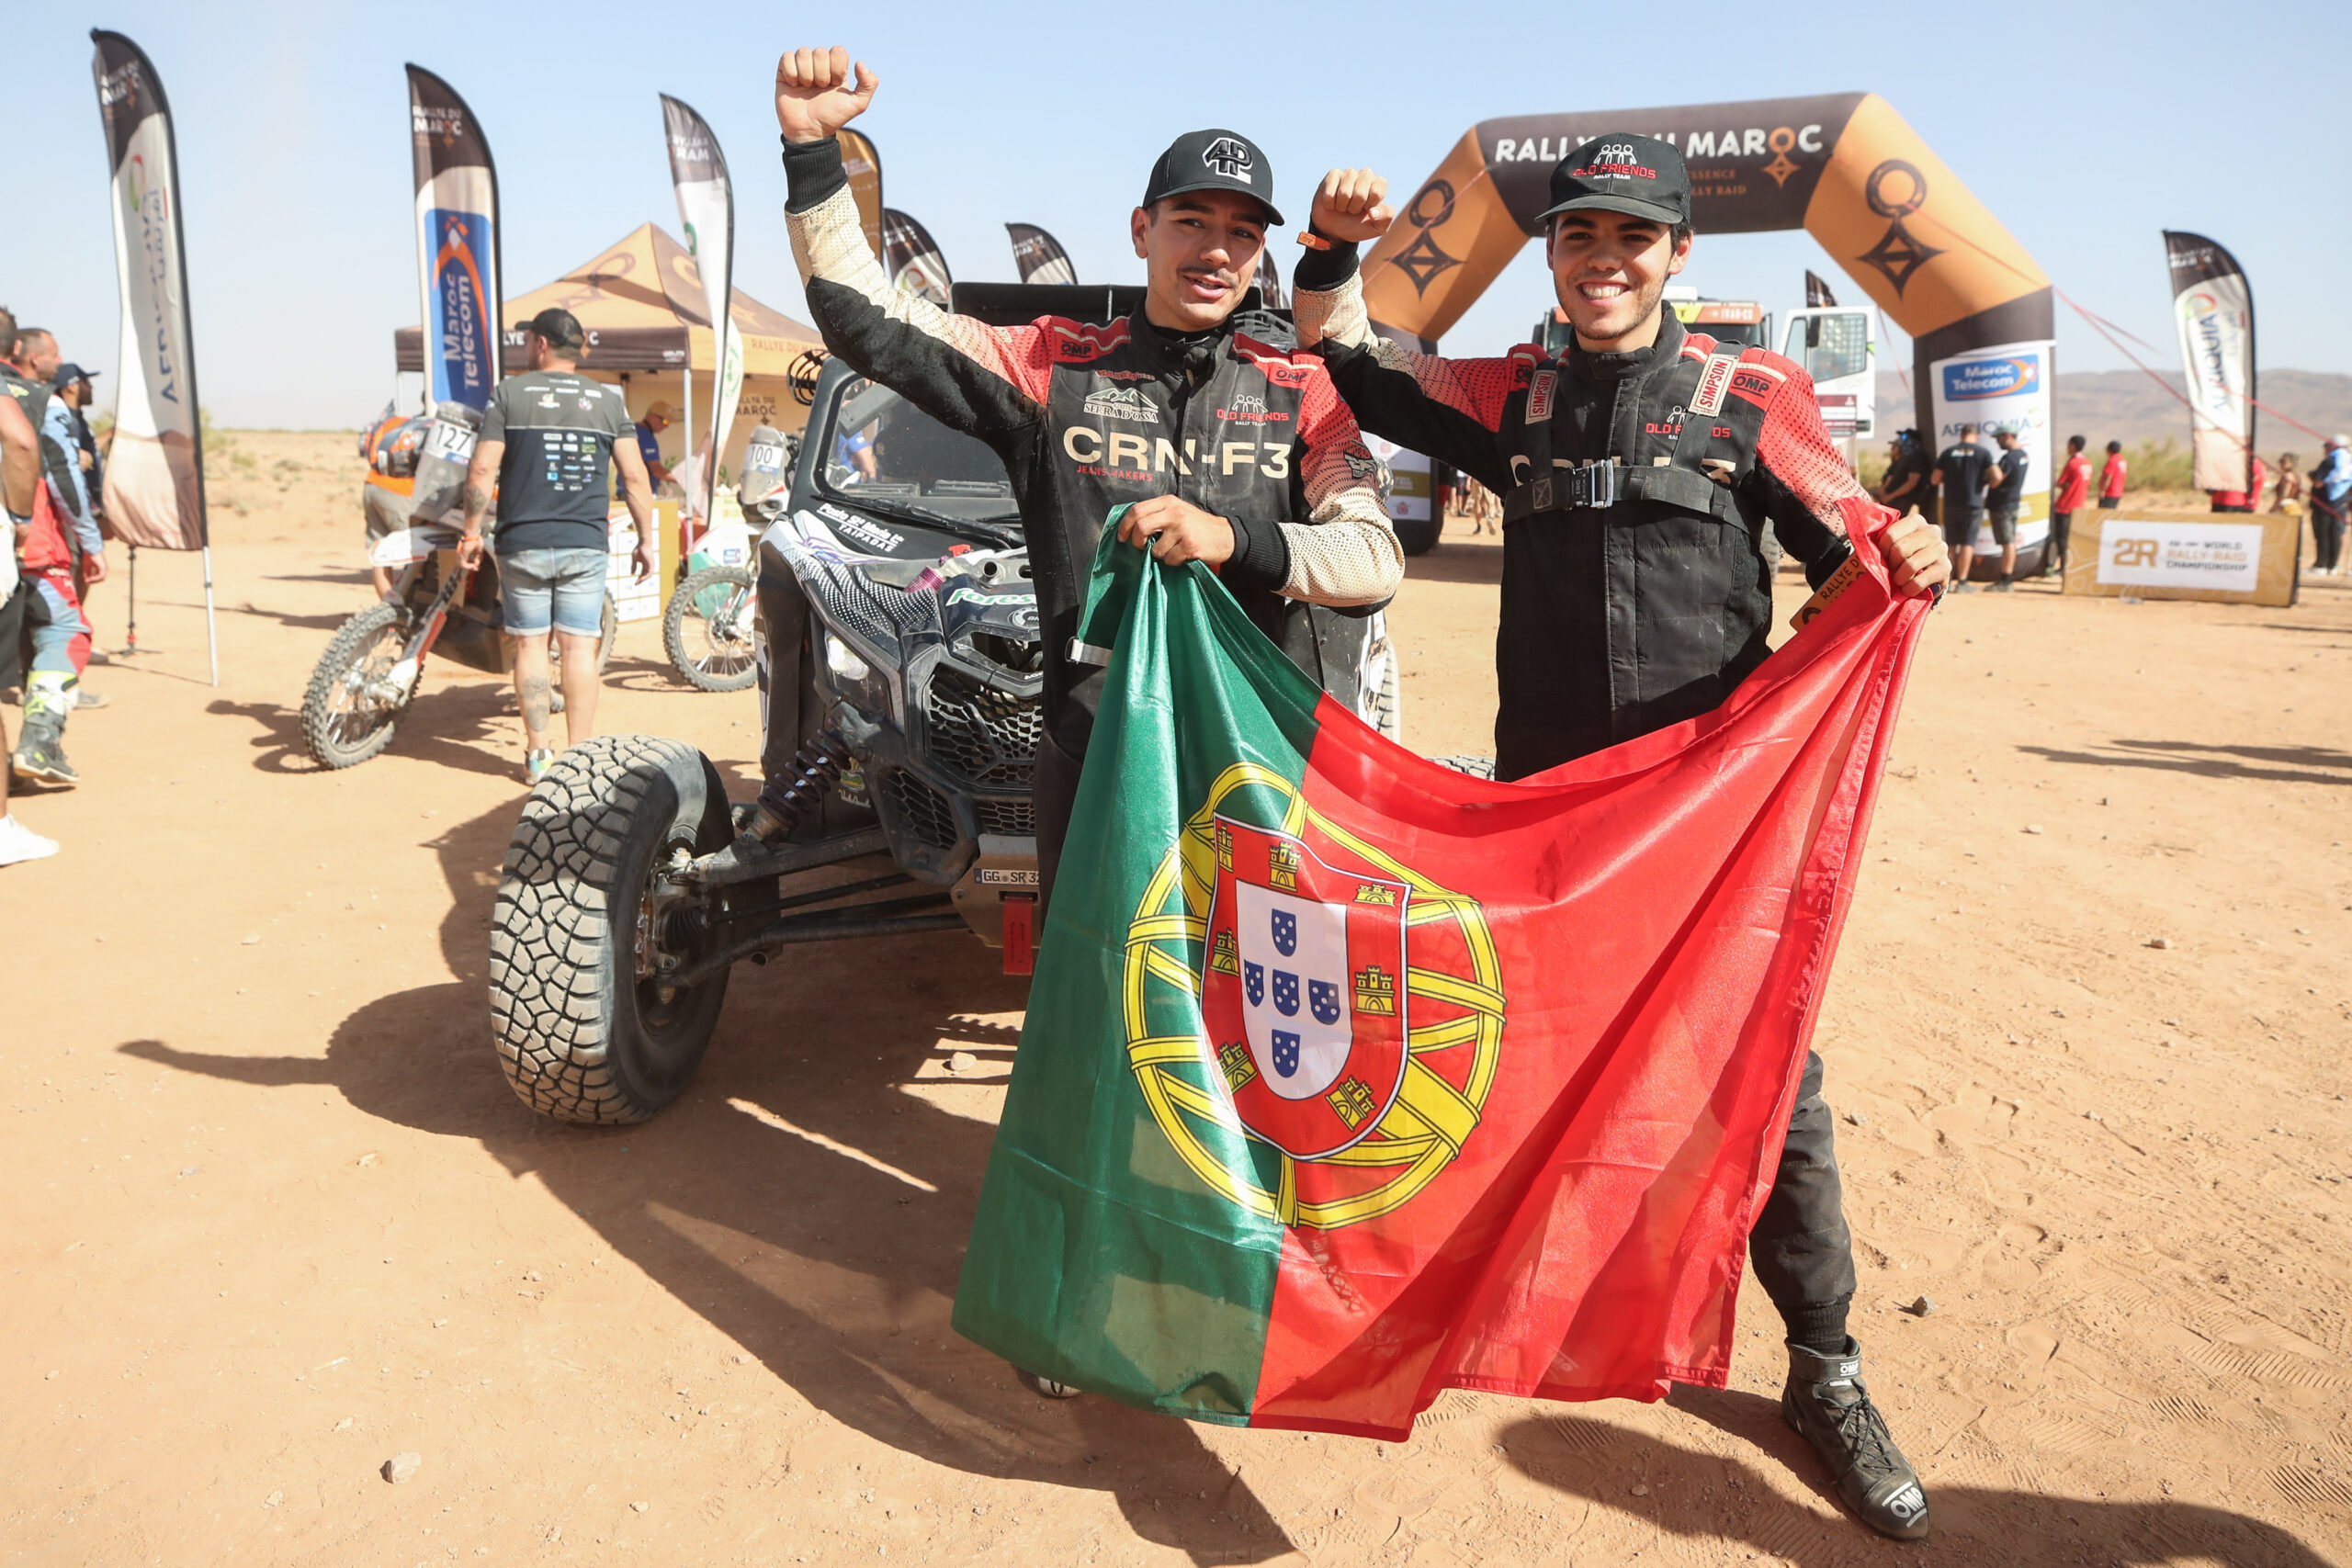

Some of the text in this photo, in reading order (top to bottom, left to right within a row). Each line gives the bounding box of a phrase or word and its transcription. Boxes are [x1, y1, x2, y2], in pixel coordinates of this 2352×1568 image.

[1495, 135, 1597, 163] RALLY
[1686, 125, 1824, 158] MAROC
[1571, 164, 1657, 180] OLD FRIENDS
[1716, 185, 1747, 195] RAID
[442, 272, 461, 361] Maroc
[458, 275, 480, 389] Telecom
[503, 332, 526, 346] LYE
[752, 338, 785, 353] RALLYE
[786, 342, 799, 354] DU
[1061, 344, 1092, 355] OMP
[1964, 365, 2013, 378] Maroc
[1700, 361, 1728, 408] SIMPSON
[1733, 375, 1770, 393] OMP
[1951, 376, 2015, 390] Telecom
[1532, 373, 1553, 414] SIMPSON
[1084, 403, 1159, 423] SERRA D'OSSA
[1216, 409, 1290, 423] OLD FRIENDS
[436, 423, 472, 452] 127
[1645, 423, 1672, 434] OLD
[750, 446, 773, 465] 100
[1063, 426, 1293, 479] CRN-F3
[1077, 465, 1154, 482] JEANS MAKERS
[839, 524, 895, 552] TAIPADAS
[1820, 566, 1853, 601] RALLYE
[983, 871, 1001, 883] GG
[1011, 872, 1026, 884] SR
[1890, 1486, 1926, 1518] OMP
